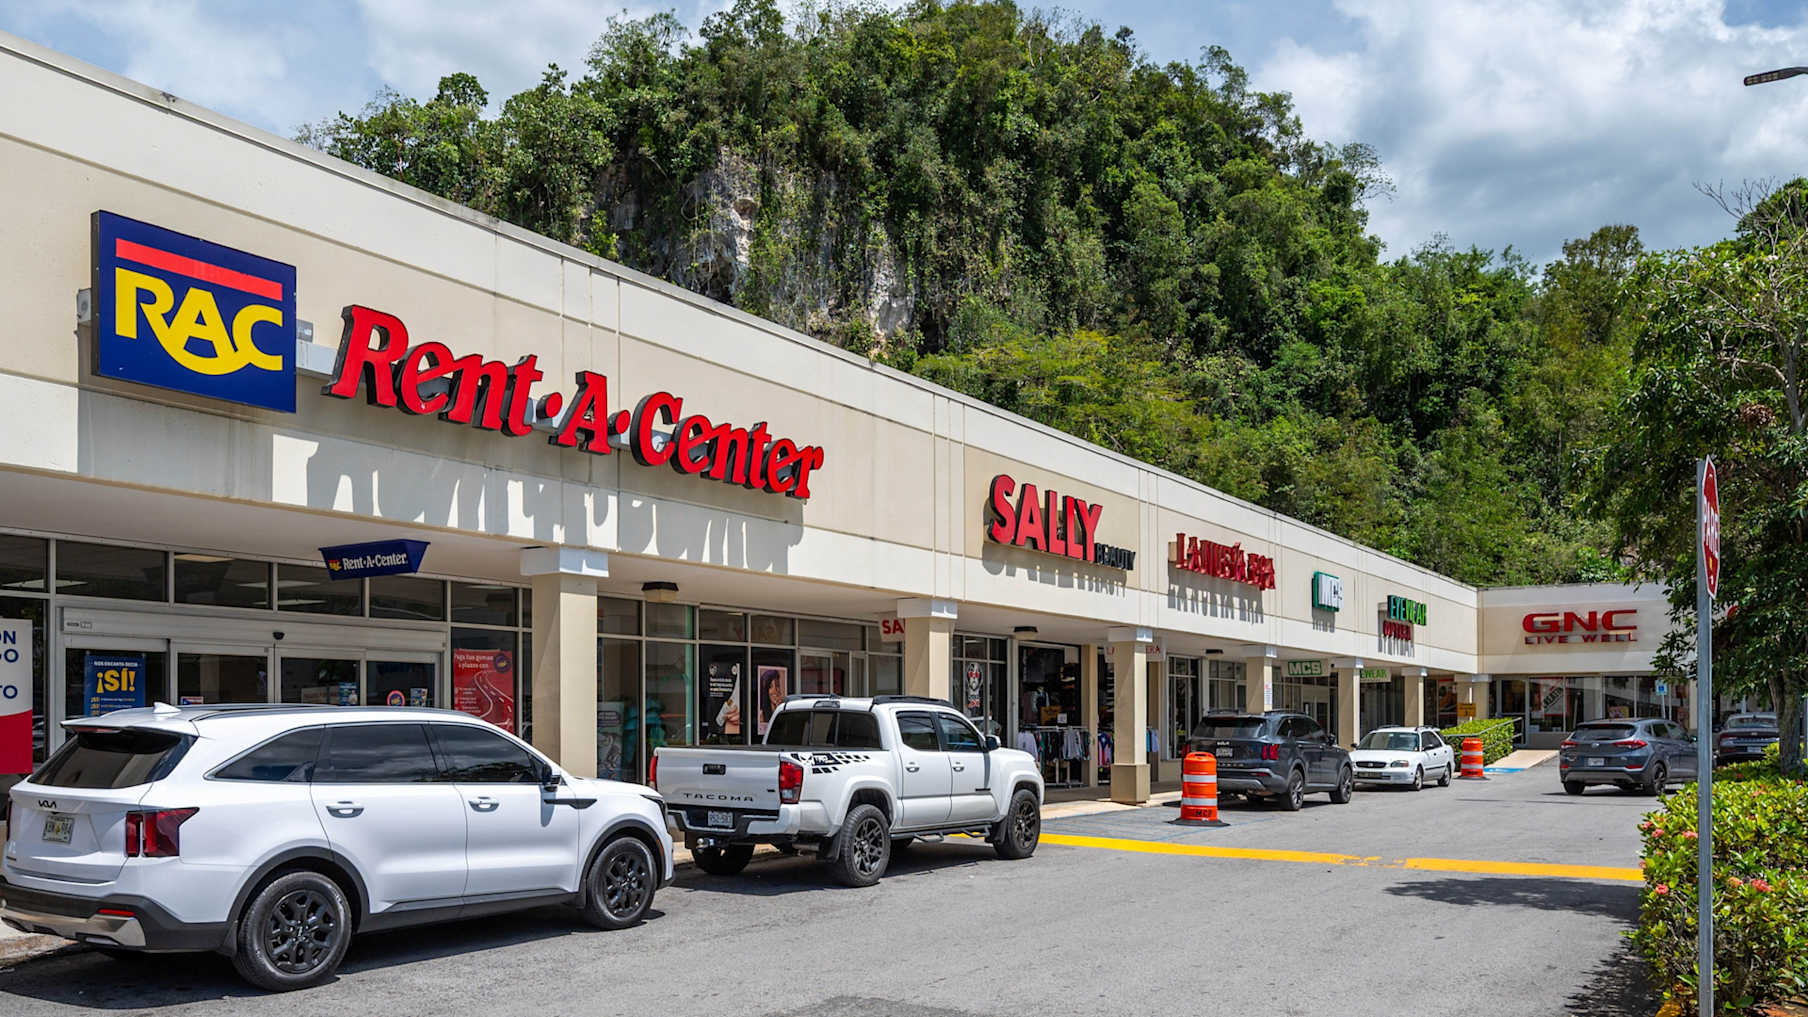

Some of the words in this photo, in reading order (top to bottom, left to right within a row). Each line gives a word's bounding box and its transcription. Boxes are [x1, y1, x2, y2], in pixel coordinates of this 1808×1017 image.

[114, 267, 283, 376] RAC
[988, 474, 1103, 562] SALLY
[1095, 543, 1136, 570] BEAUTY
[1387, 595, 1427, 626] EYEWEAR
[882, 619, 906, 634] SA
[1522, 609, 1638, 633] GNC
[0, 630, 16, 645] N
[1524, 635, 1569, 645] LIVE
[1582, 632, 1638, 643] WELL
[0, 648, 19, 663] O
[1290, 661, 1321, 674] MCS
[96, 668, 136, 693] ¡SÍ!
[683, 793, 754, 802] TACOMA
